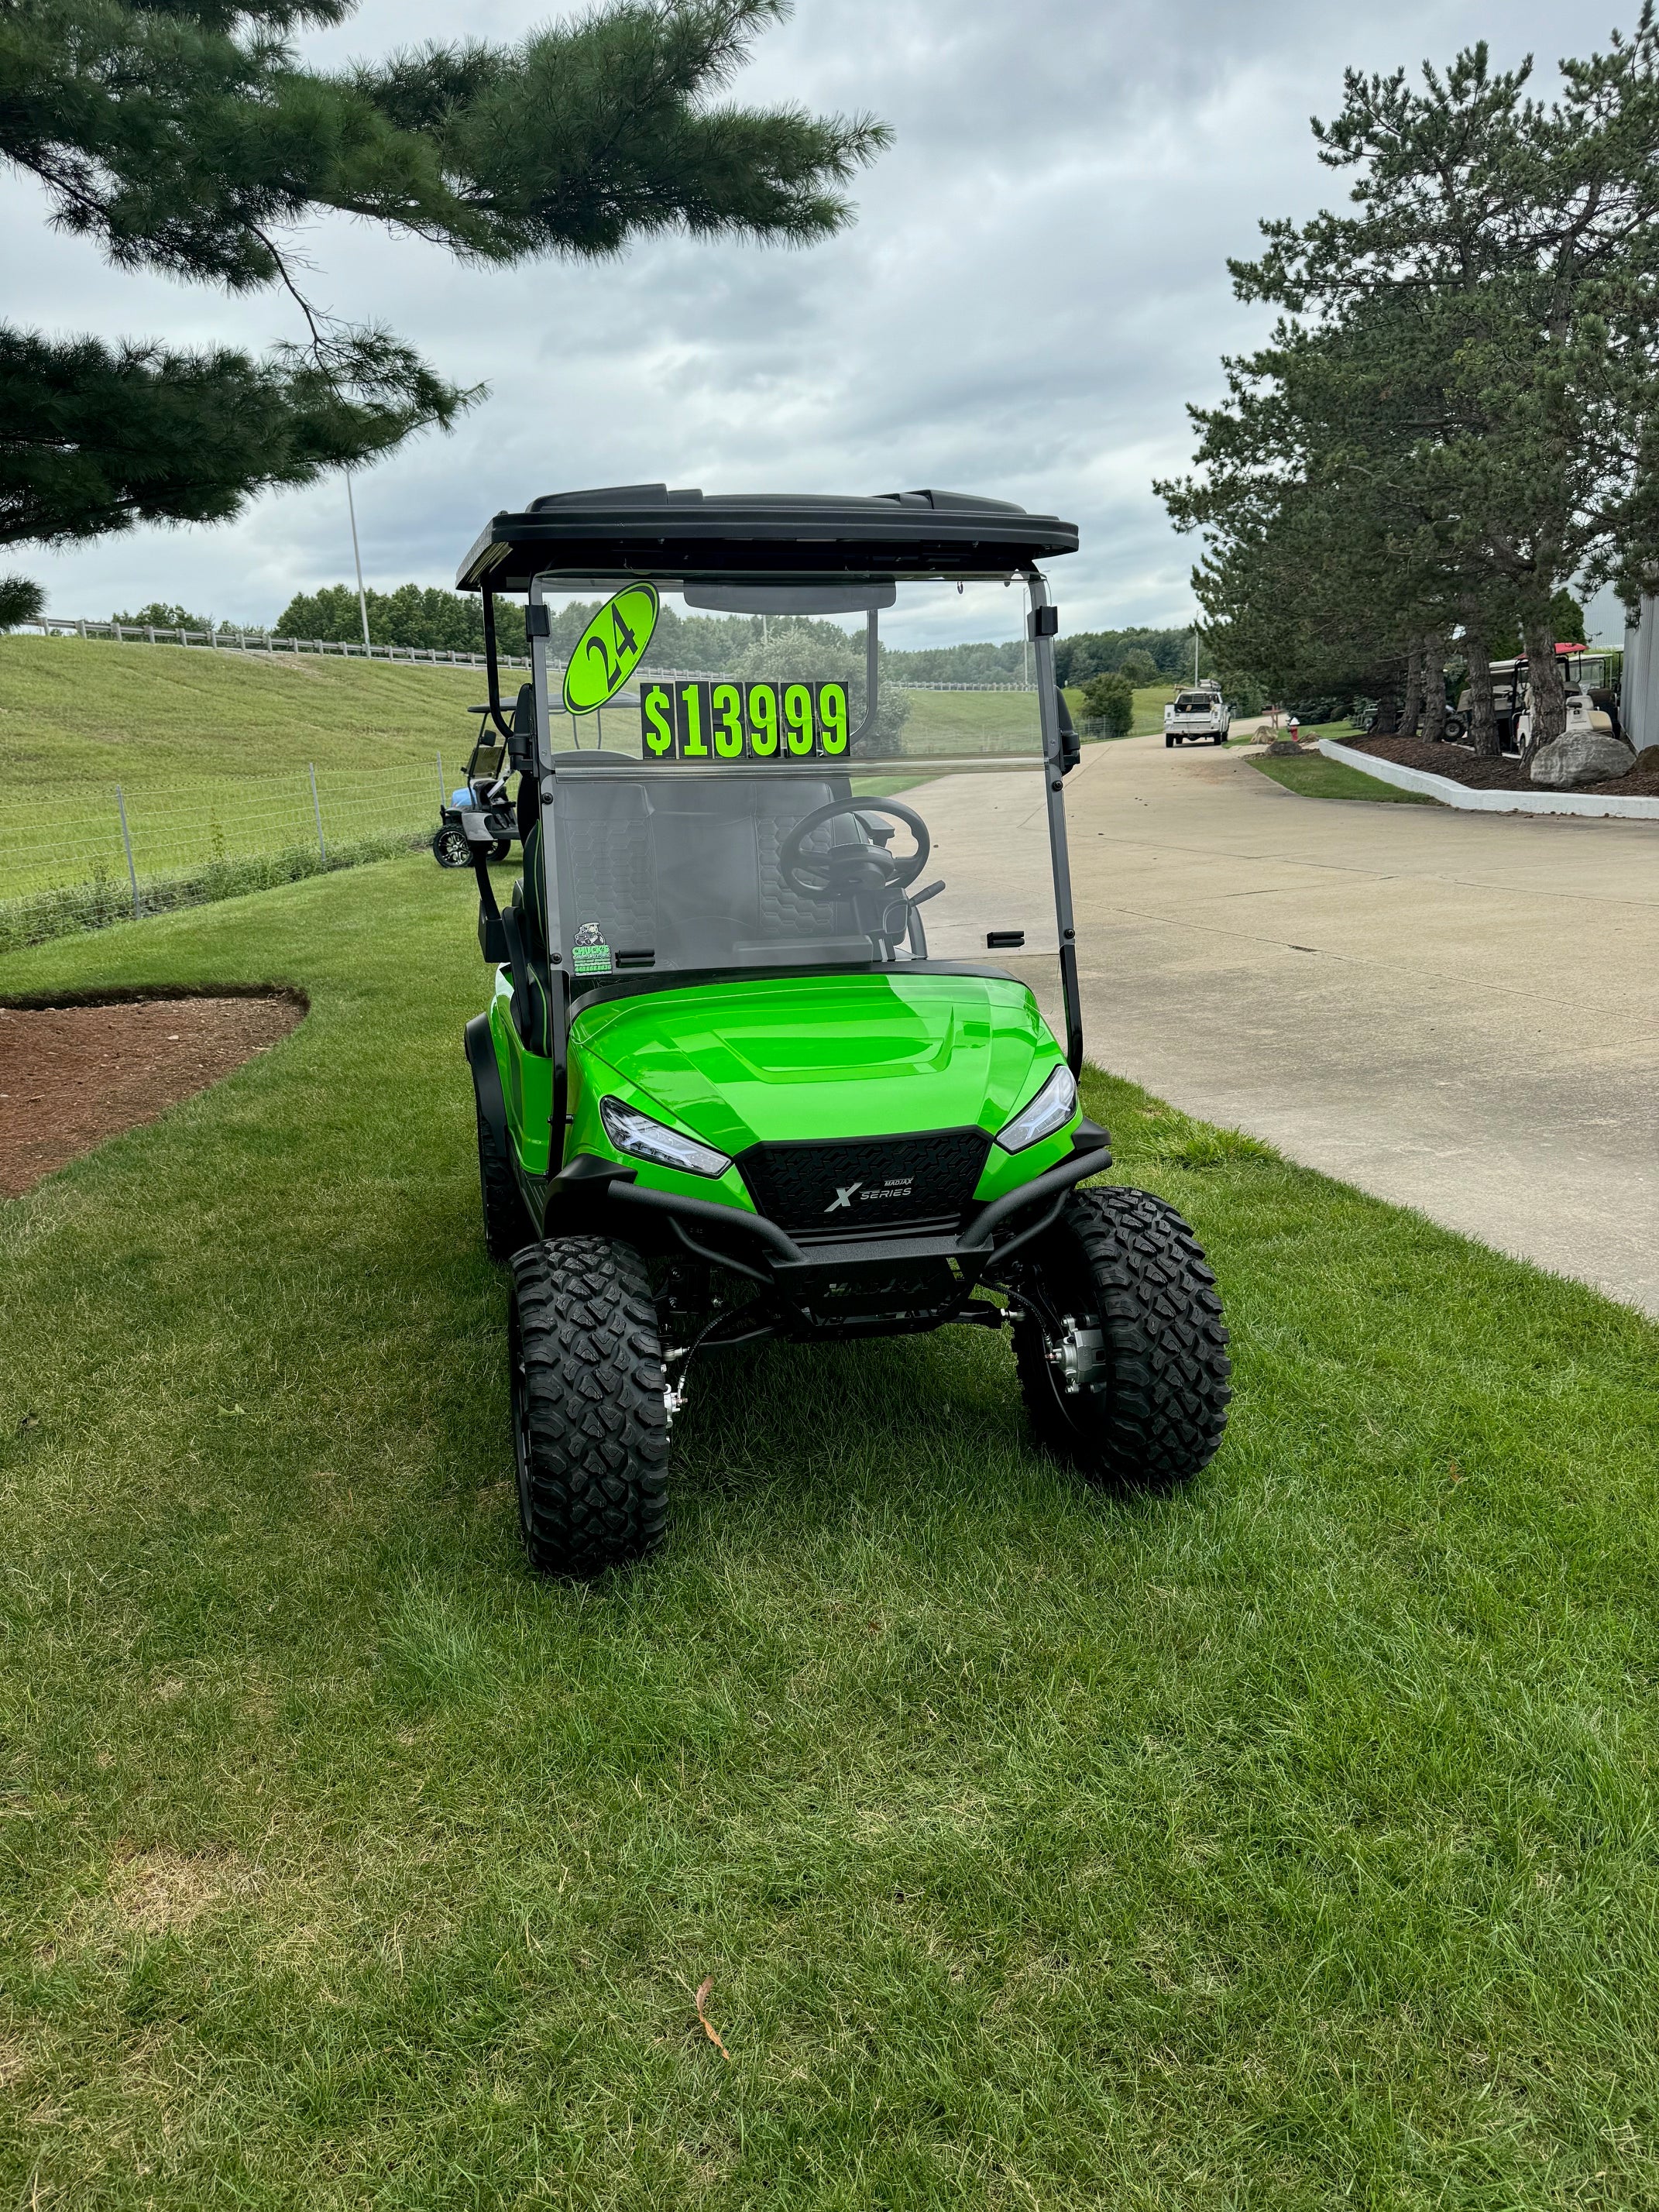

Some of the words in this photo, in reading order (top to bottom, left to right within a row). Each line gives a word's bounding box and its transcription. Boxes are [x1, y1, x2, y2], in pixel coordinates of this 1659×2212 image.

[586, 602, 639, 692] 24
[644, 684, 848, 757] $13999
[823, 1182, 864, 1213] X
[860, 1187, 912, 1200] SERIES
[884, 1177, 915, 1187] MADJAX
